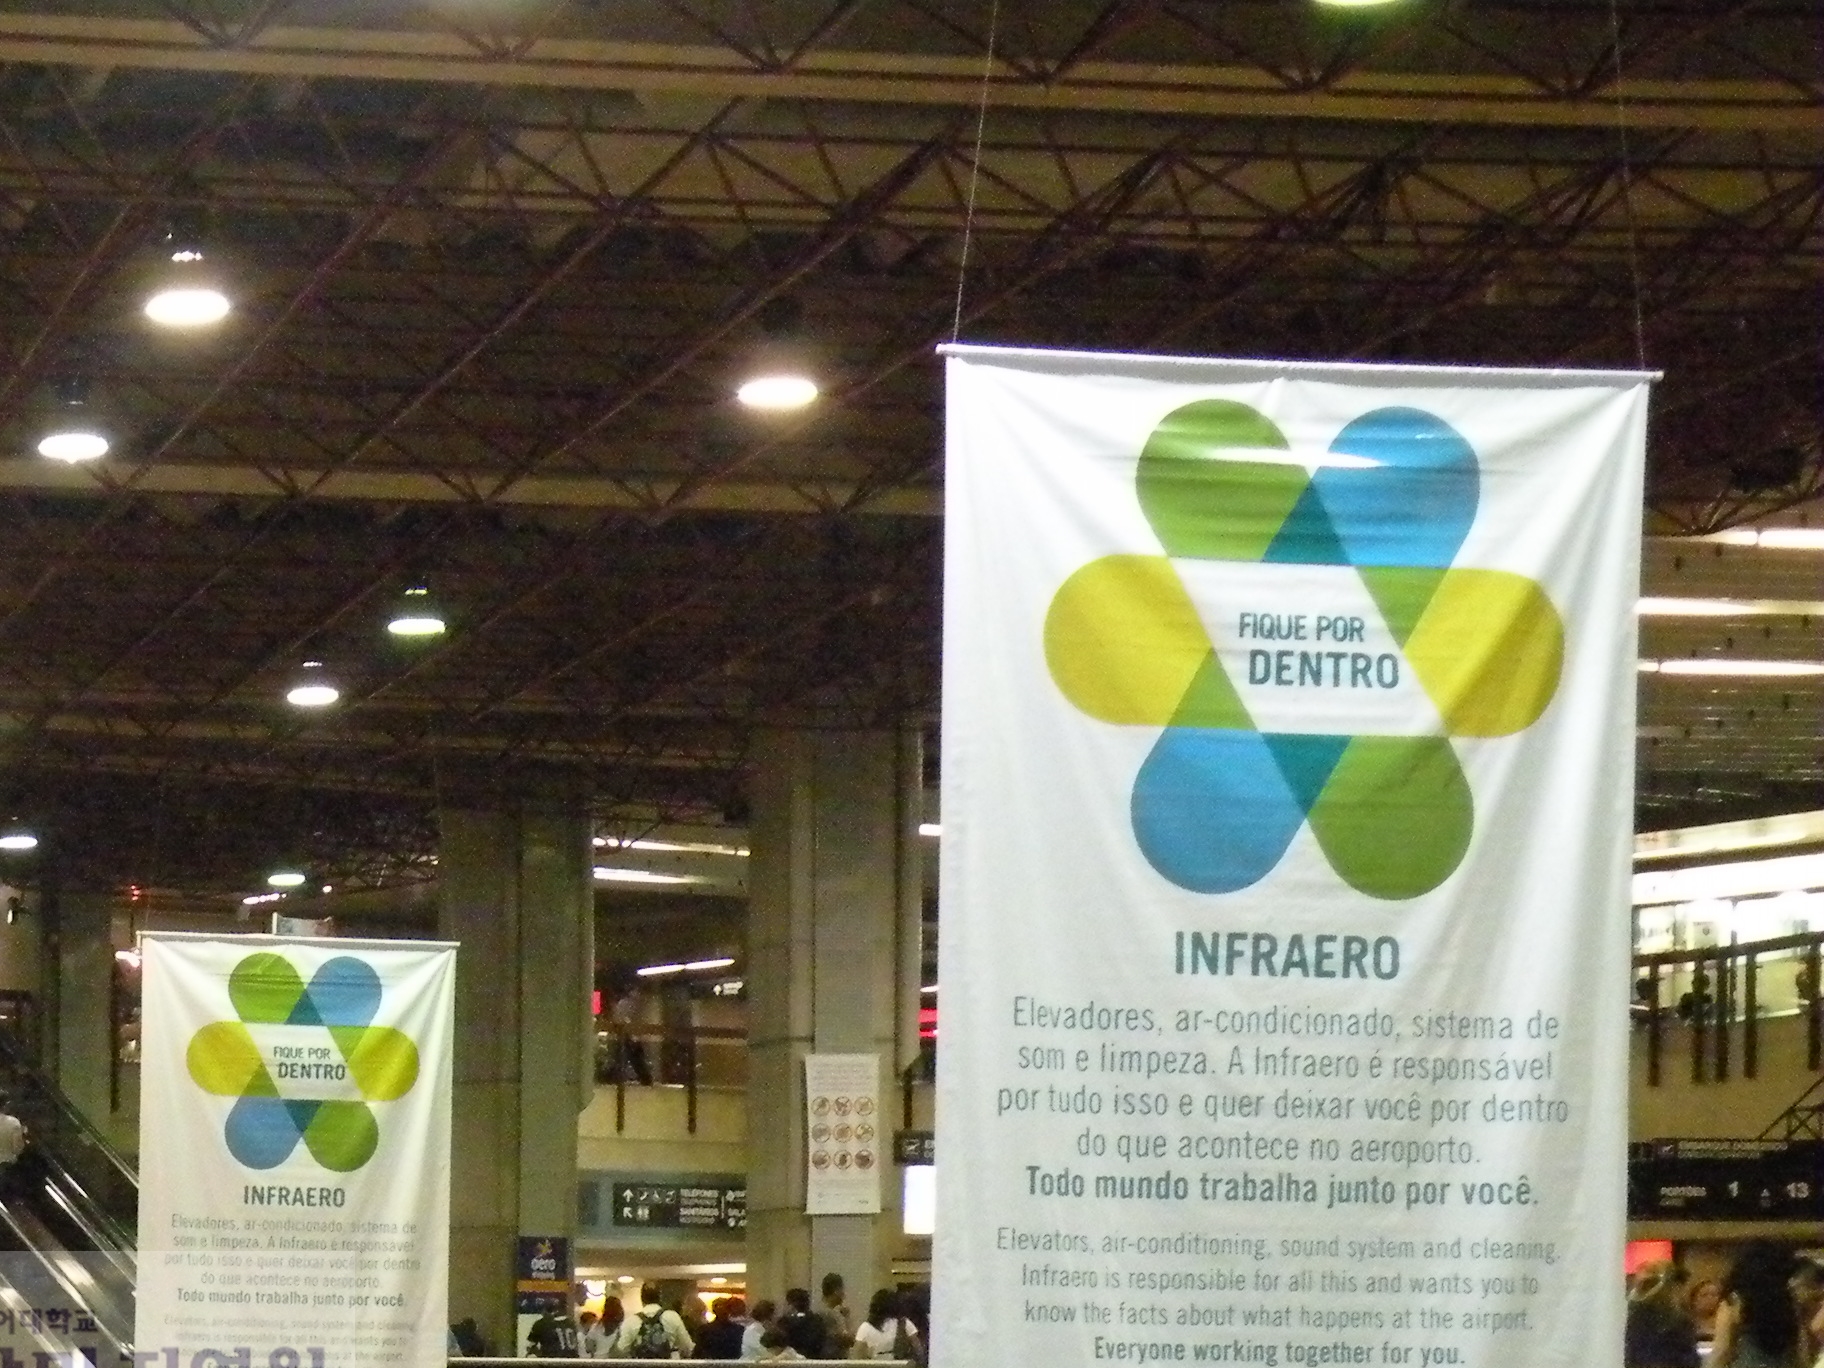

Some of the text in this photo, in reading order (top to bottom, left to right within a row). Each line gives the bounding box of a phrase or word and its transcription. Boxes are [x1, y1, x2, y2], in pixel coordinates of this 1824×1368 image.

[1238, 612, 1365, 642] FIQUE POR
[1248, 648, 1399, 688] DENTRO
[1175, 931, 1400, 979] INFRAERO
[1012, 995, 1560, 1042] Elevadores, ar-condicionado, sistema de
[273, 1047, 331, 1060] FIQUE POR
[1017, 1043, 1553, 1085] som e limpeza. A Infraero é responsável
[277, 1061, 346, 1081] DENTRO
[996, 1085, 1570, 1126] por tudo isso e quer deixar você por dentro
[1076, 1127, 1480, 1168] do que acontece no aeroporto.
[243, 1186, 347, 1208] INFRAERO
[1026, 1165, 1539, 1209] Todo mundo trabalha junto por você.
[1787, 1181, 1810, 1199] 13
[1279, 1235, 1341, 1258] sound
[1347, 1238, 1416, 1262] system
[1422, 1237, 1463, 1258] and
[1021, 1263, 1099, 1288] Infraero
[1104, 1267, 1122, 1288] is
[1128, 1269, 1247, 1292] responsible
[1253, 1270, 1281, 1291] for
[1287, 1270, 1314, 1291] all
[1320, 1271, 1359, 1293] this
[1364, 1273, 1403, 1293] and
[1409, 1274, 1474, 1293] wants
[1481, 1277, 1517, 1298] you
[176, 1287, 205, 1303] Todo
[208, 1290, 251, 1304] mundo
[255, 1289, 309, 1305] trabalha
[348, 1293, 369, 1308] por
[1023, 1299, 1078, 1322] know
[1082, 1302, 1112, 1323] the
[1118, 1302, 1170, 1325] facts
[1175, 1303, 1237, 1326] about
[1241, 1305, 1293, 1327] what
[1298, 1307, 1386, 1334] happens
[1391, 1309, 1412, 1328] at
[1419, 1309, 1454, 1328] the
[556, 1327, 577, 1350] 10
[1093, 1336, 1465, 1368] Everyone working together for you.
